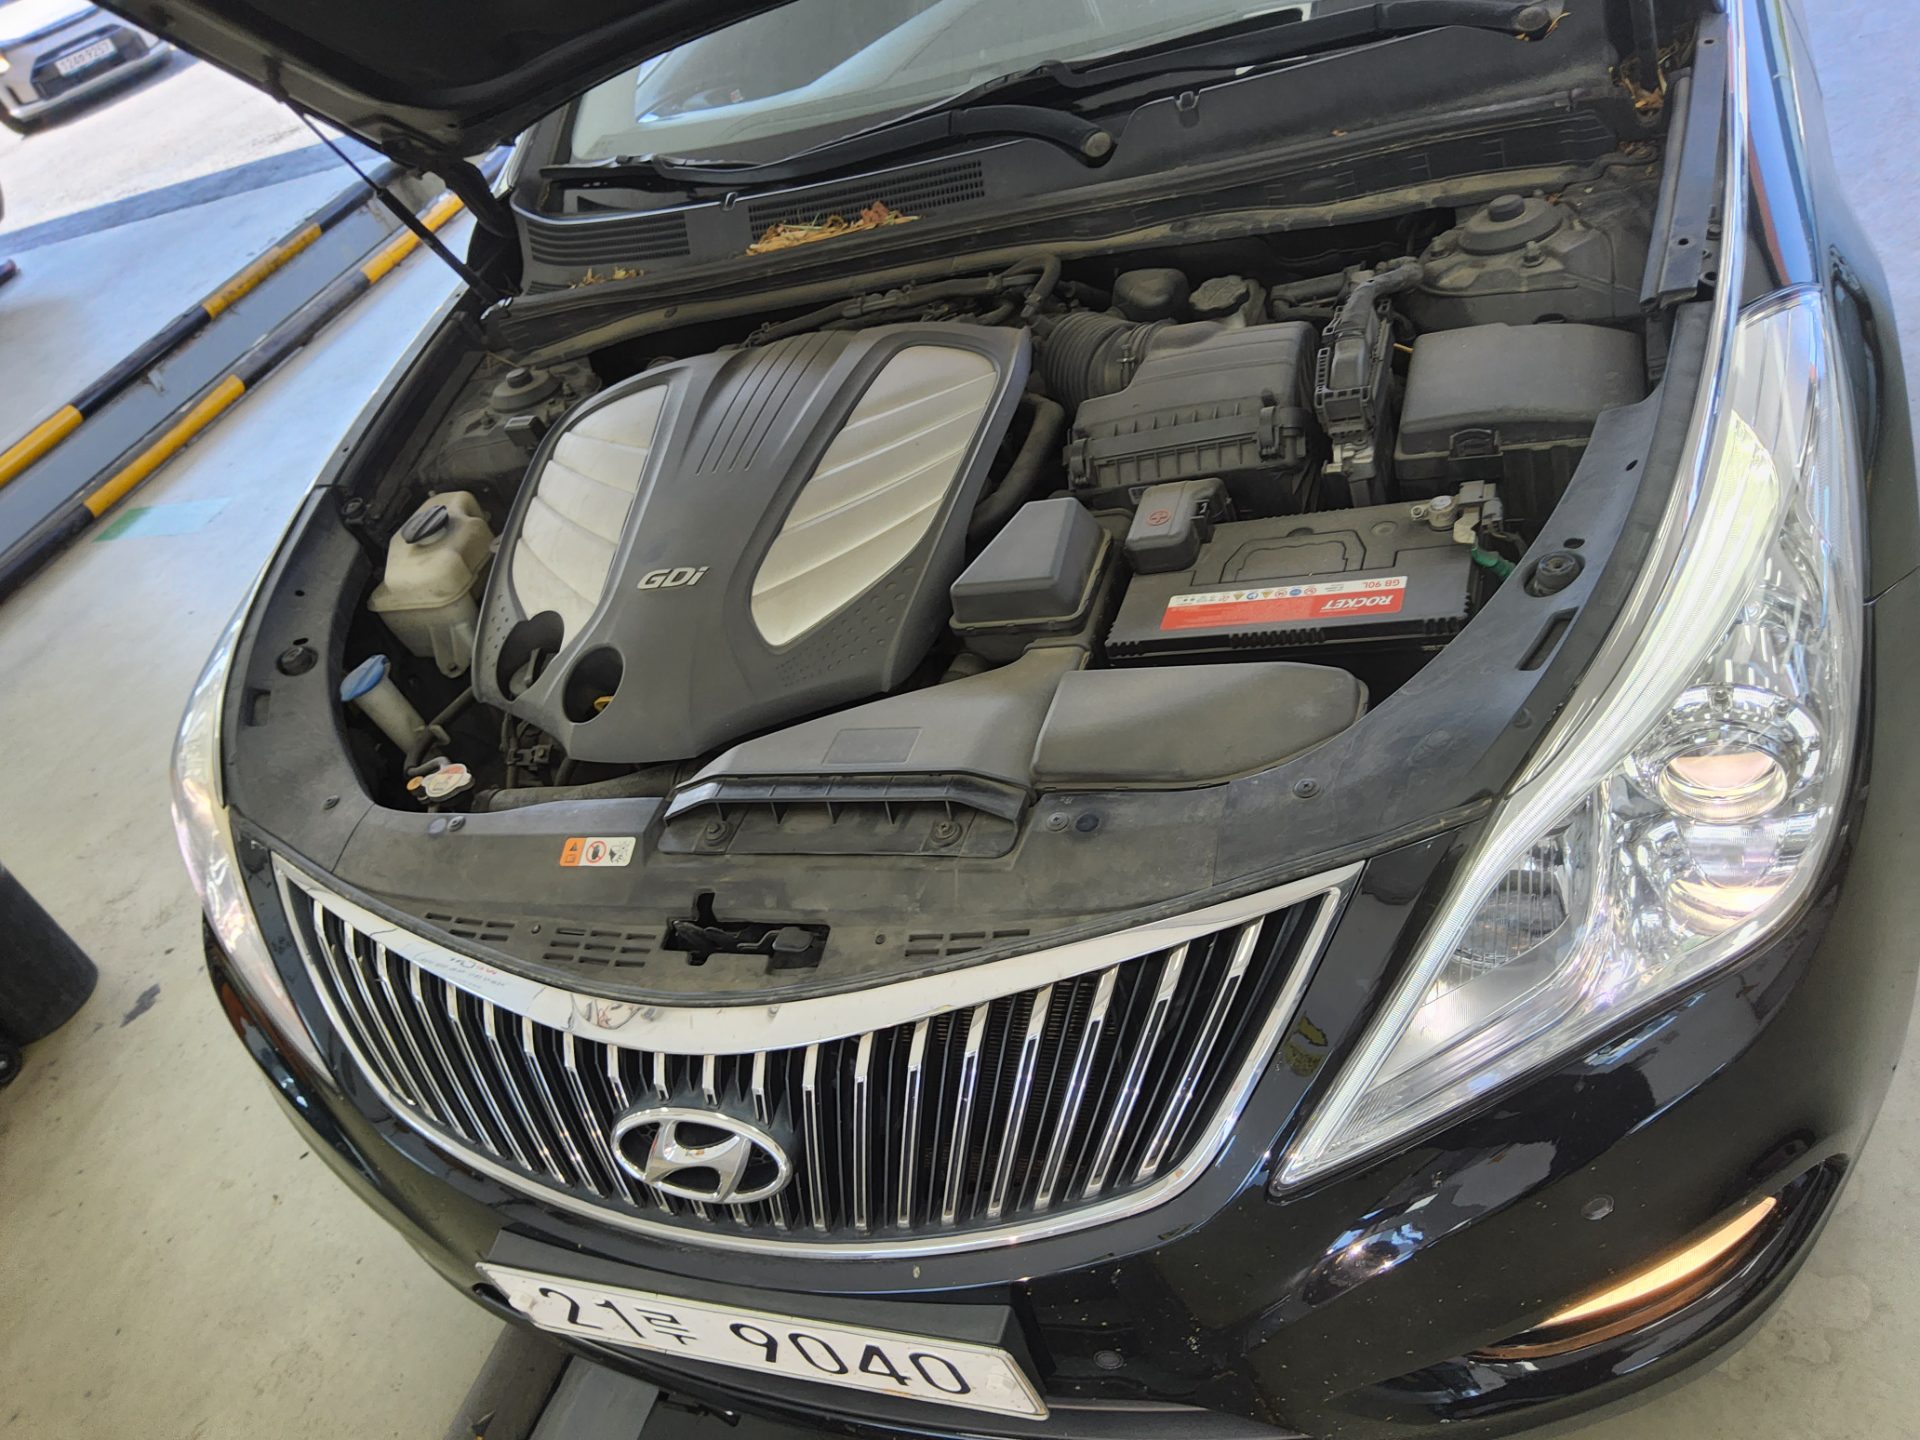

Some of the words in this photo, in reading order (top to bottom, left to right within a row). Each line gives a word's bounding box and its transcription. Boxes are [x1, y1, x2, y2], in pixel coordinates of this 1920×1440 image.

[637, 566, 710, 590] GDi
[1361, 581, 1382, 589] 90L
[1384, 579, 1400, 587] GB
[1321, 595, 1394, 610] ROCKET
[538, 1286, 699, 1347] 21루
[729, 1322, 972, 1395] 9040
